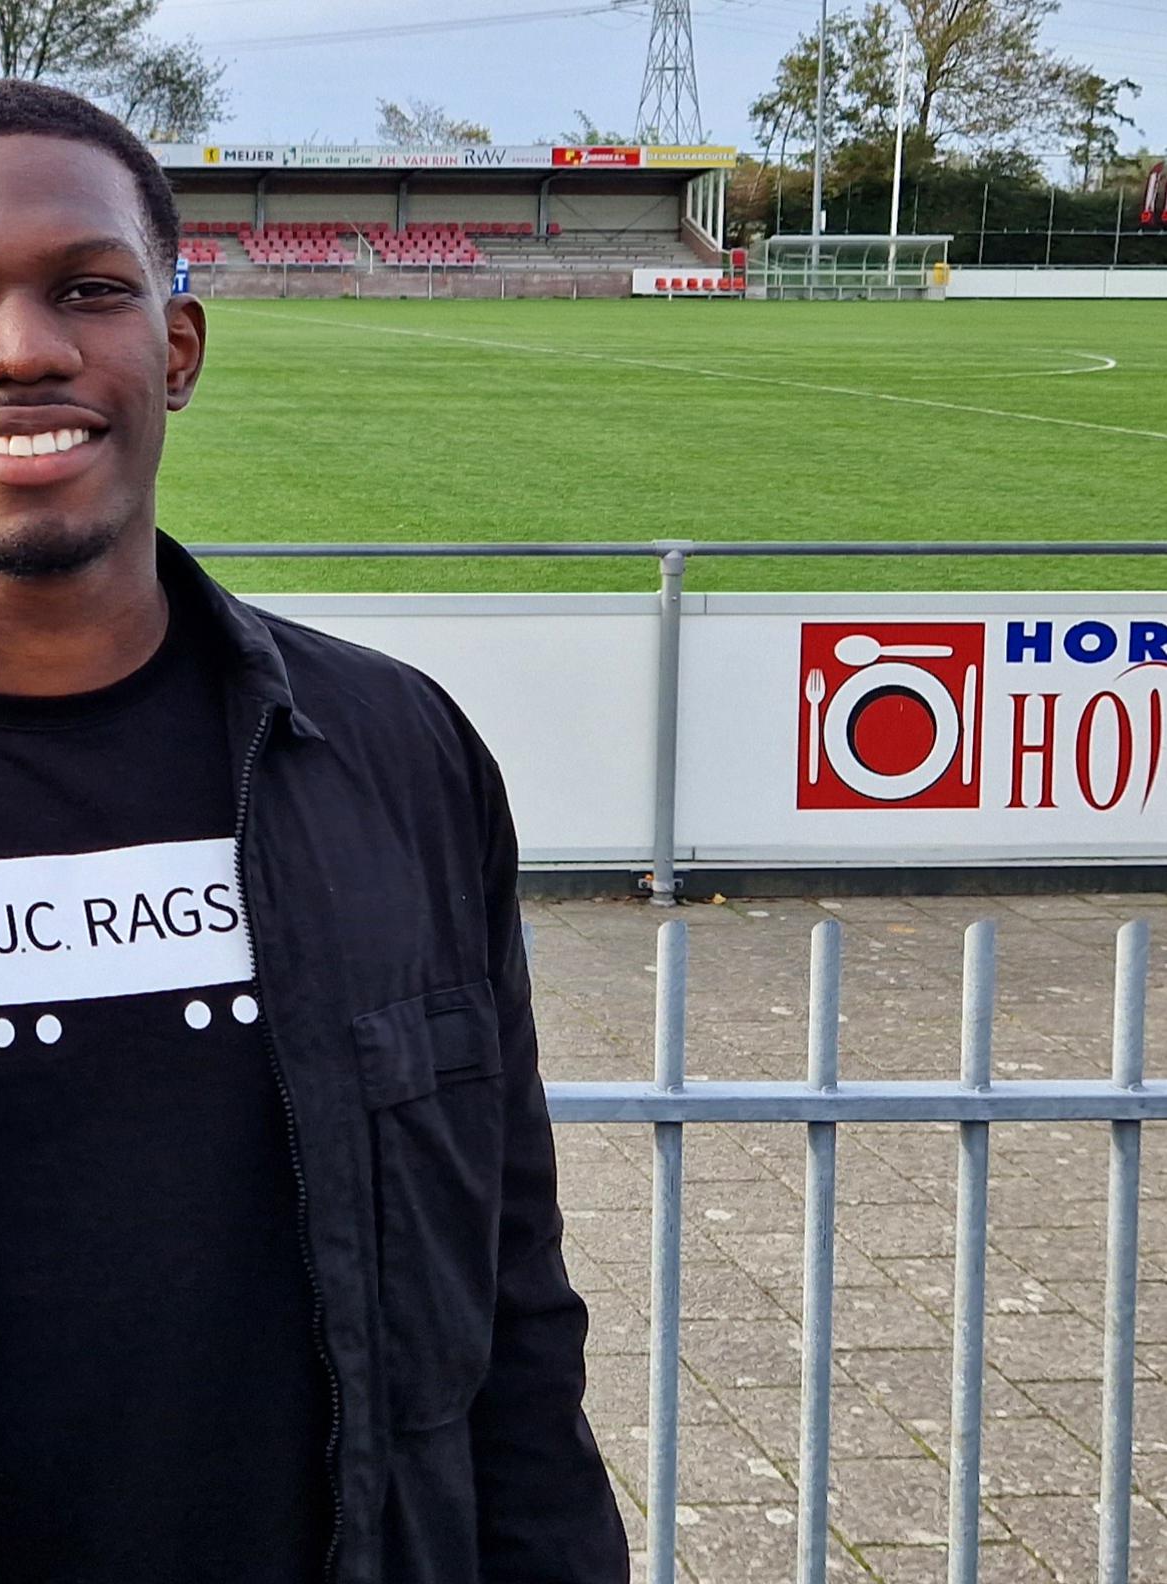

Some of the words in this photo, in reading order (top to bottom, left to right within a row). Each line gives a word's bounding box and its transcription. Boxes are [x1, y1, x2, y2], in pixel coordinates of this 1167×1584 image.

[224, 150, 274, 162] MEIJER
[300, 155, 319, 165] jan
[325, 155, 340, 164] de
[403, 155, 428, 165] VAN
[432, 155, 458, 165] RIJN
[1006, 620, 1167, 664] HOR
[83, 883, 240, 947] RAGS
